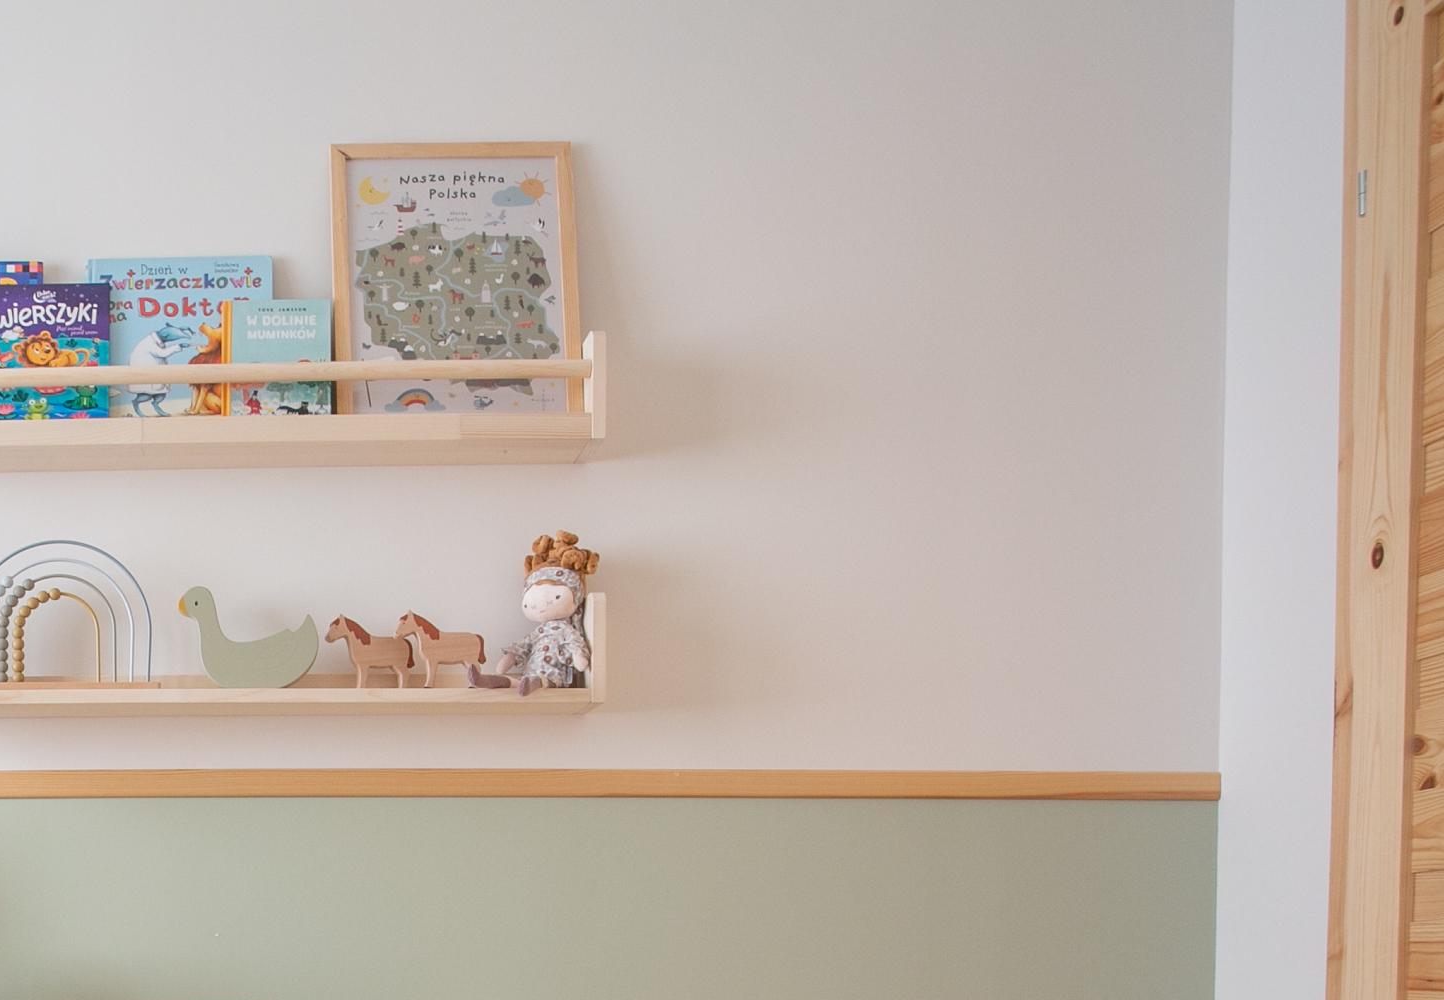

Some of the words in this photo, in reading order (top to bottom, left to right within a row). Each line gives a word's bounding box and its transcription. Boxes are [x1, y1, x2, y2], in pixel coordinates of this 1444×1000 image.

[400, 174, 445, 184] Nasza
[453, 171, 505, 186] piękna
[429, 188, 477, 200] Polska
[141, 264, 173, 275] Dzień
[178, 267, 188, 275] w
[246, 314, 257, 326] W
[262, 314, 317, 327] DOLINIE
[246, 329, 317, 340] MUMINKÓW
